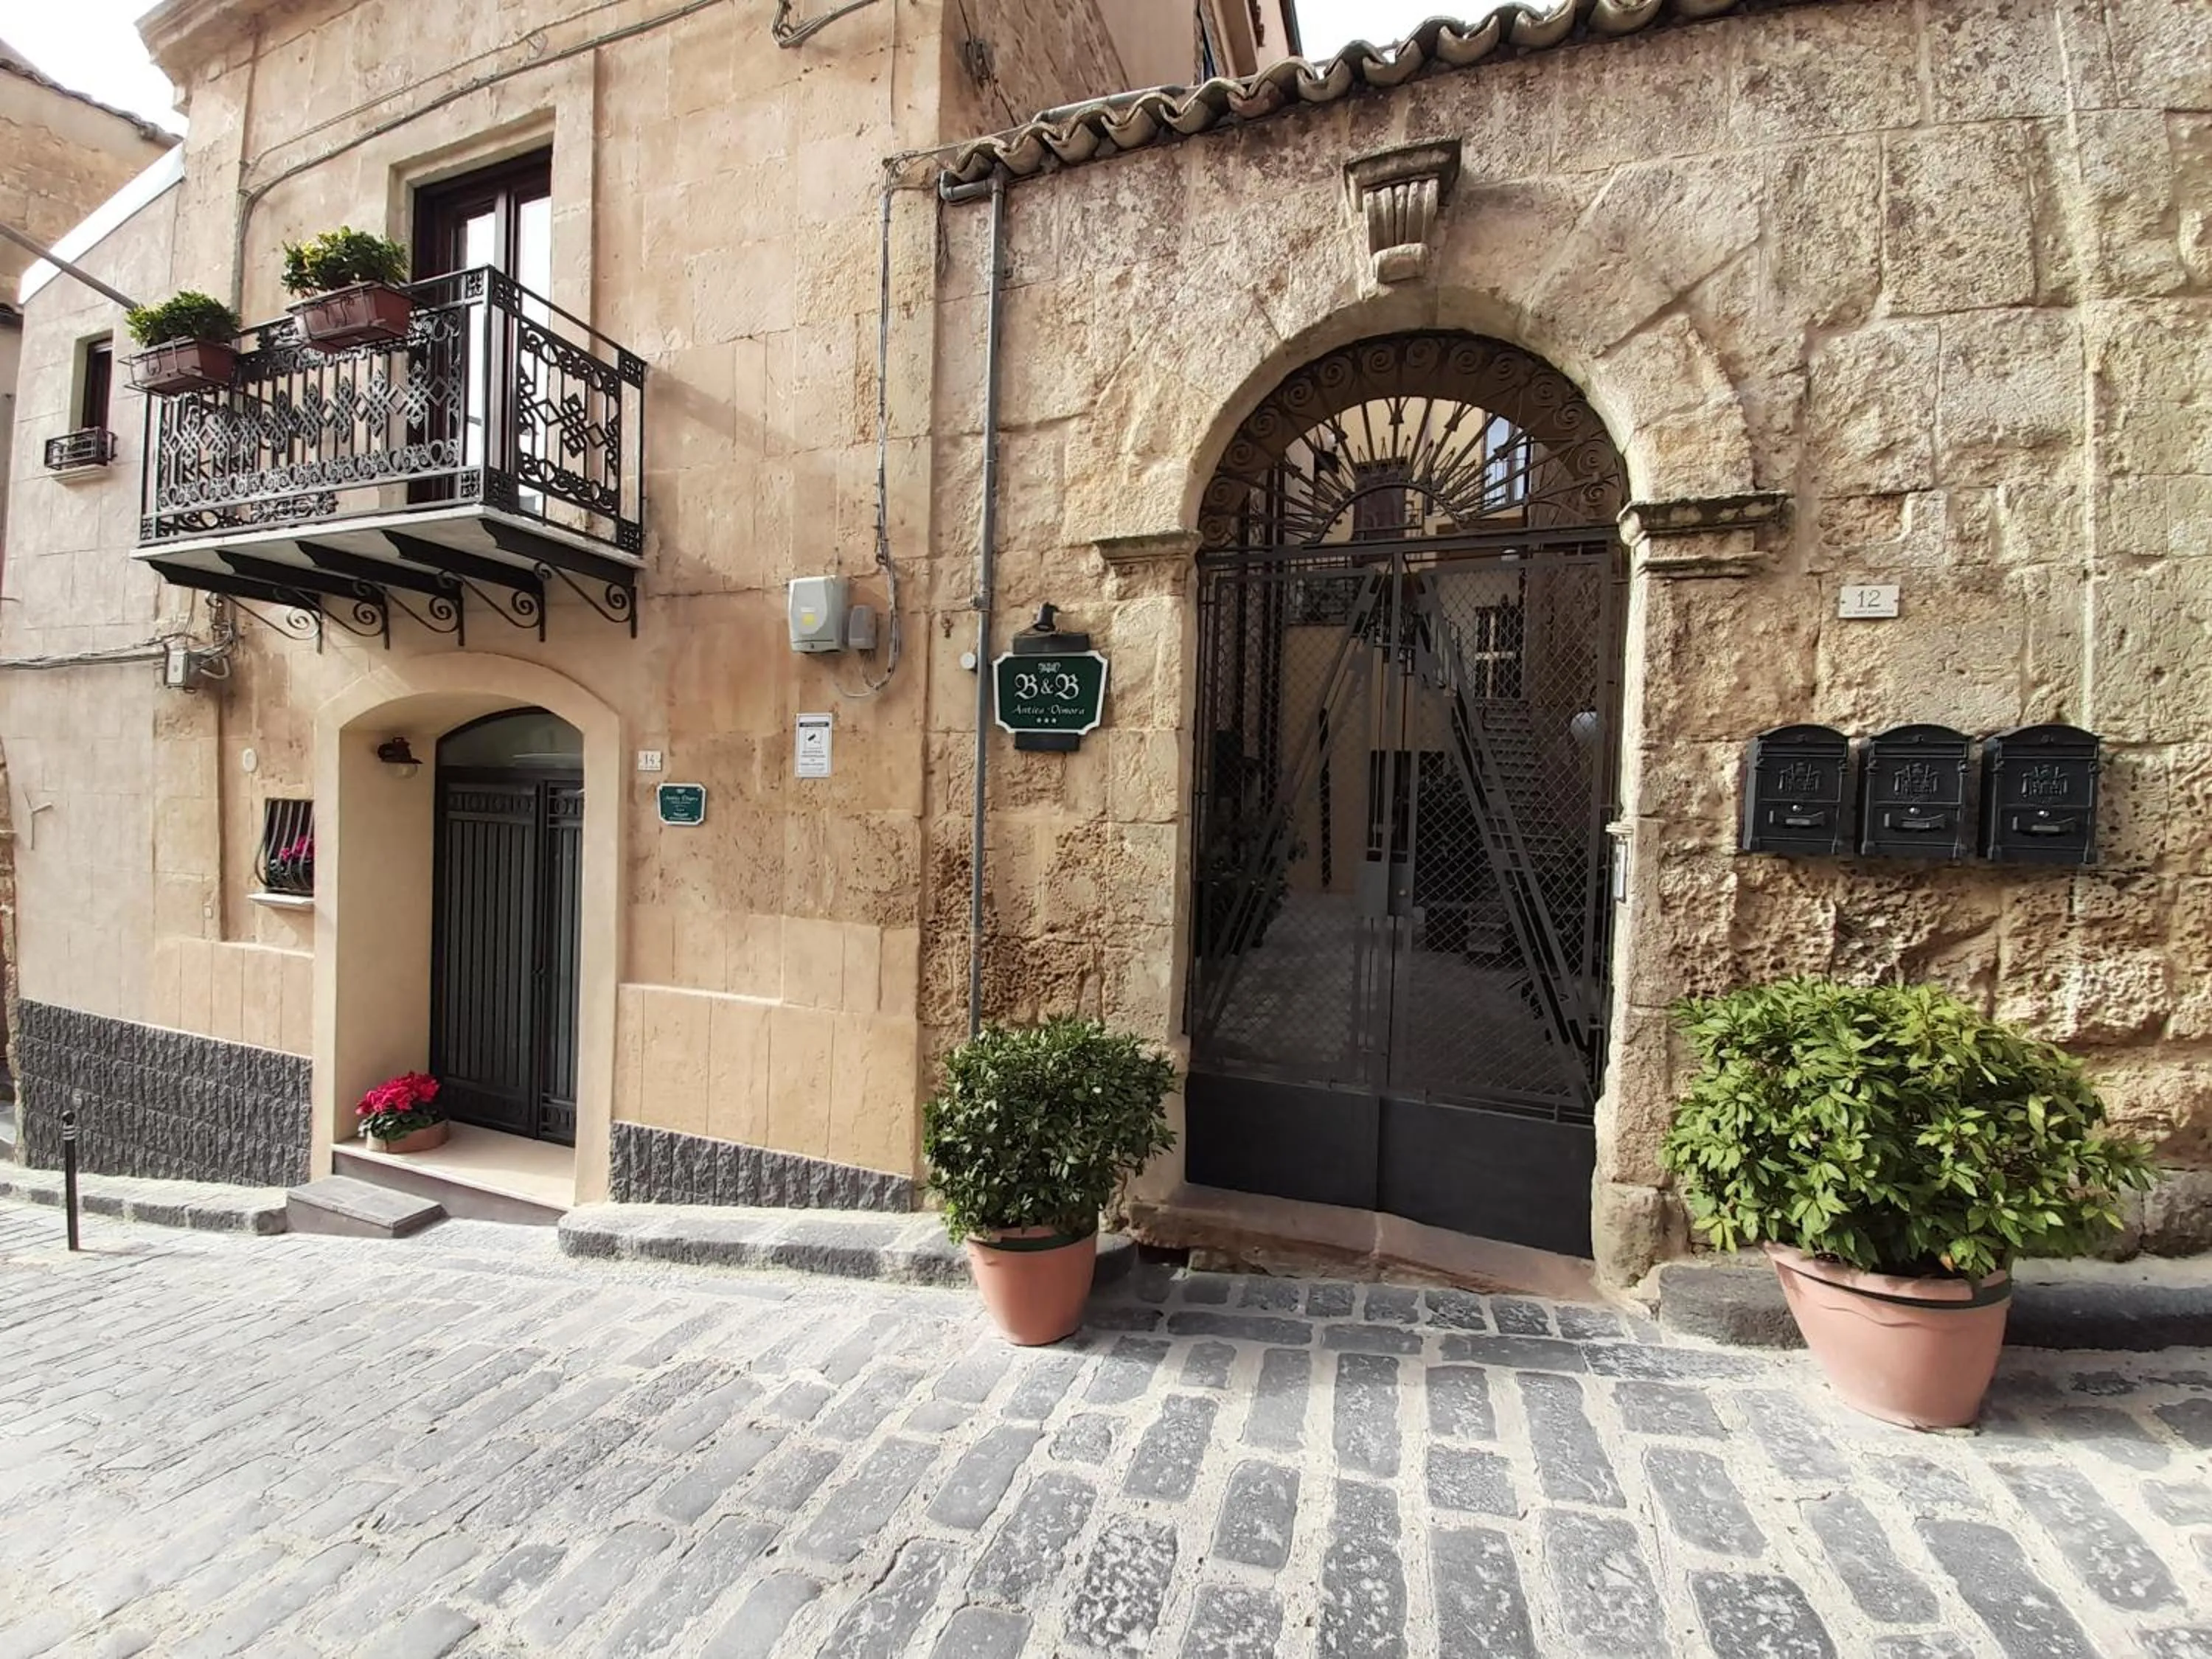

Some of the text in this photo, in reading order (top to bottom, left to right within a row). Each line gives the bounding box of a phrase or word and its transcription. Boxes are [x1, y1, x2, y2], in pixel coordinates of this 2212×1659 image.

[1857, 589, 1882, 608] 12
[1014, 673, 1079, 700] B&B
[1011, 704, 1045, 714] Antica
